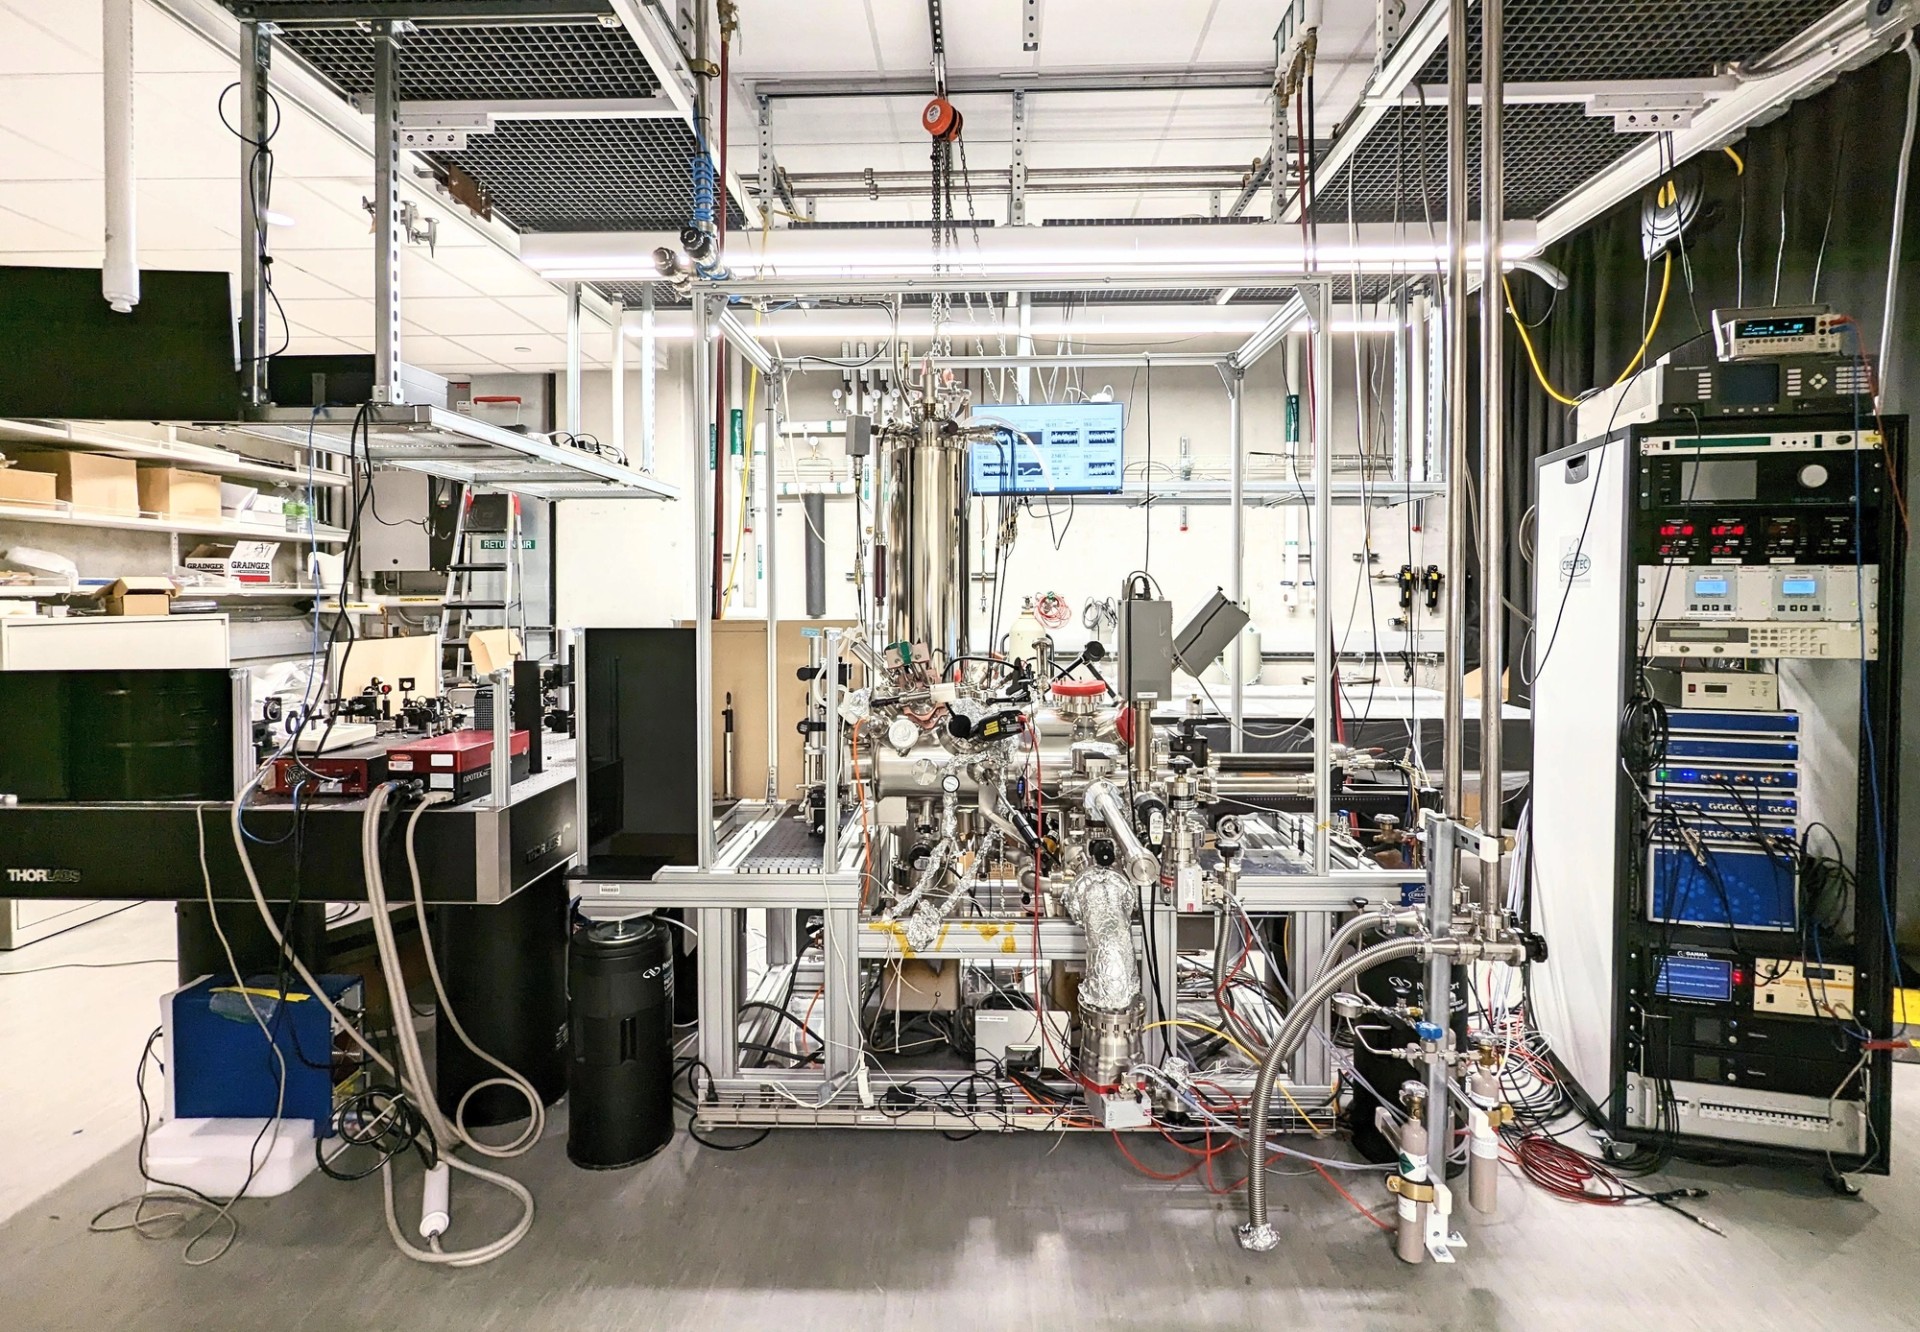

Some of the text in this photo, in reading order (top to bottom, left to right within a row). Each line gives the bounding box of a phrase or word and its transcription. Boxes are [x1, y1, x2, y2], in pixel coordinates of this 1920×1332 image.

[187, 562, 224, 570] GRAINGER
[231, 561, 270, 570] GRAINGER
[463, 773, 483, 783] OPOTEK
[7, 869, 81, 882] THORLABS
